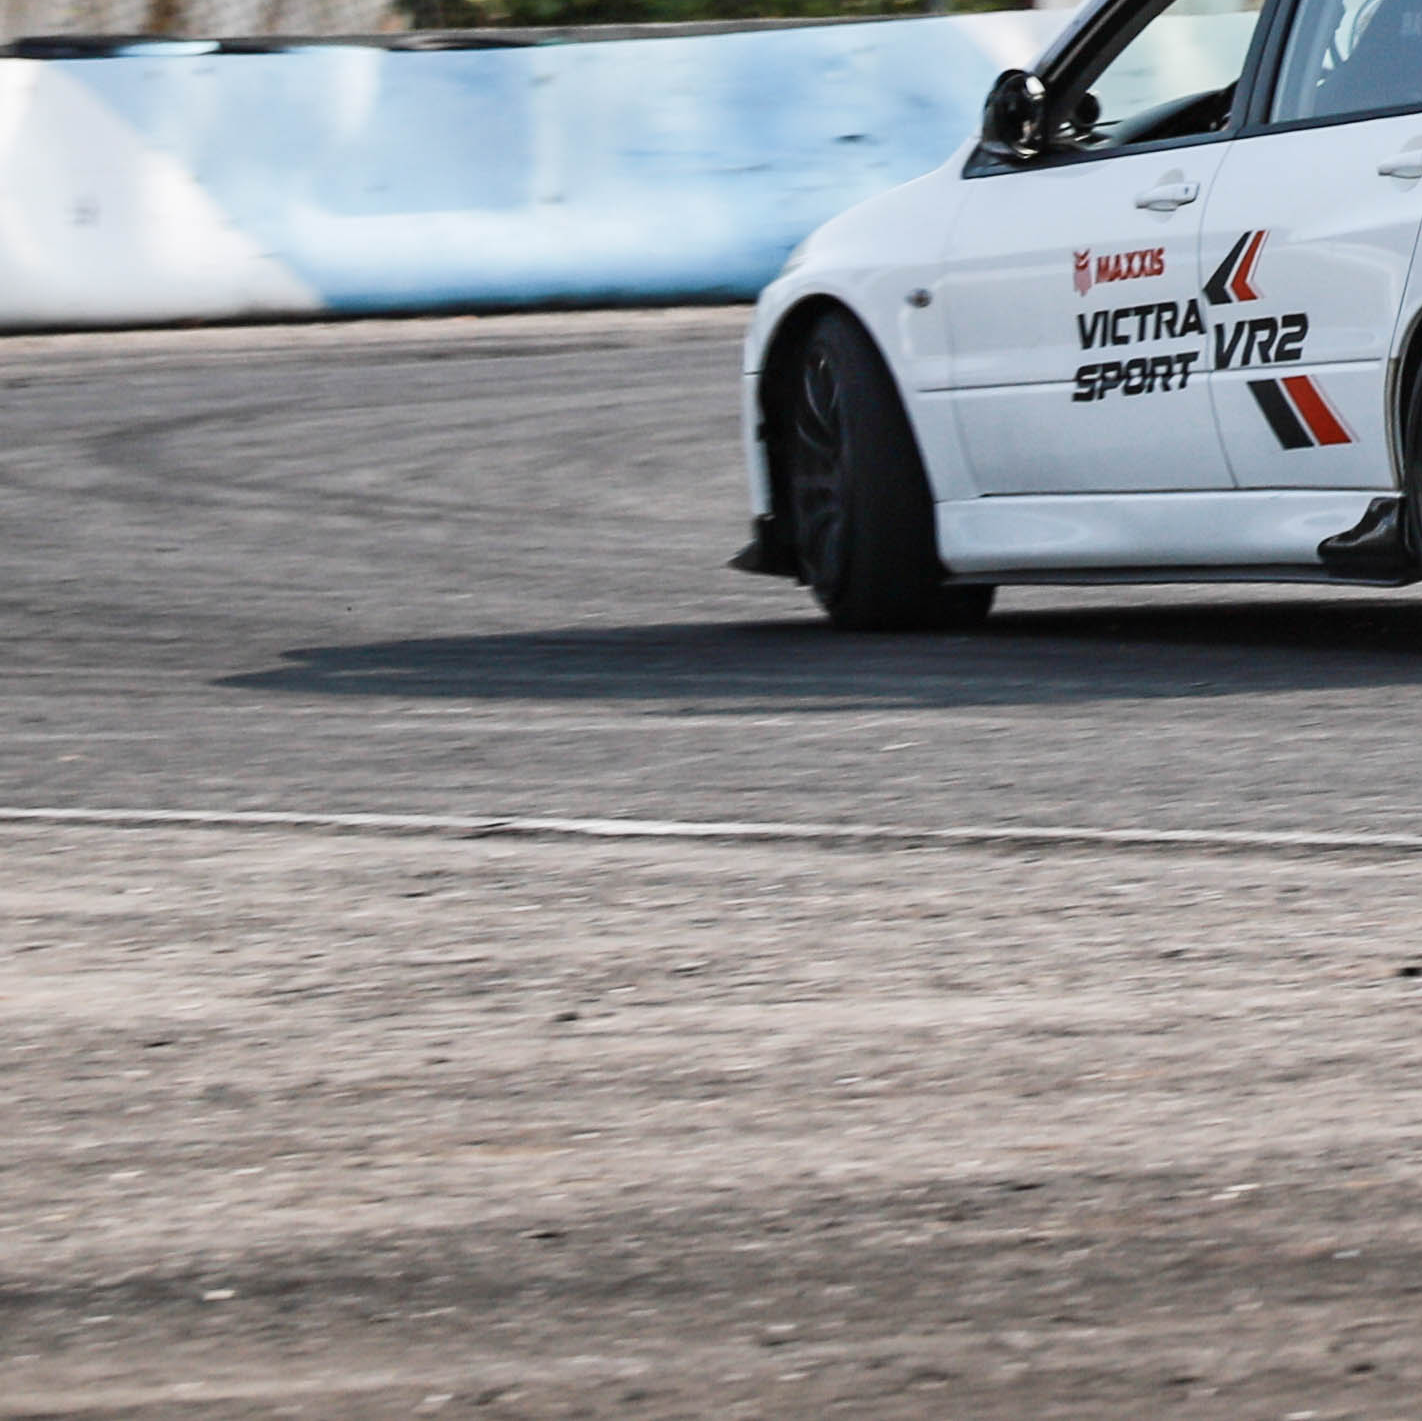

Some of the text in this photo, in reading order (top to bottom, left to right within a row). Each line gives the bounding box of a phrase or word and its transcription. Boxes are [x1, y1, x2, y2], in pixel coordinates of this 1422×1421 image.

[1095, 247, 1165, 284] MAXXIS
[1077, 298, 1207, 350] VICTRA
[1214, 313, 1309, 370] VR2
[1072, 351, 1200, 402] SPORT
